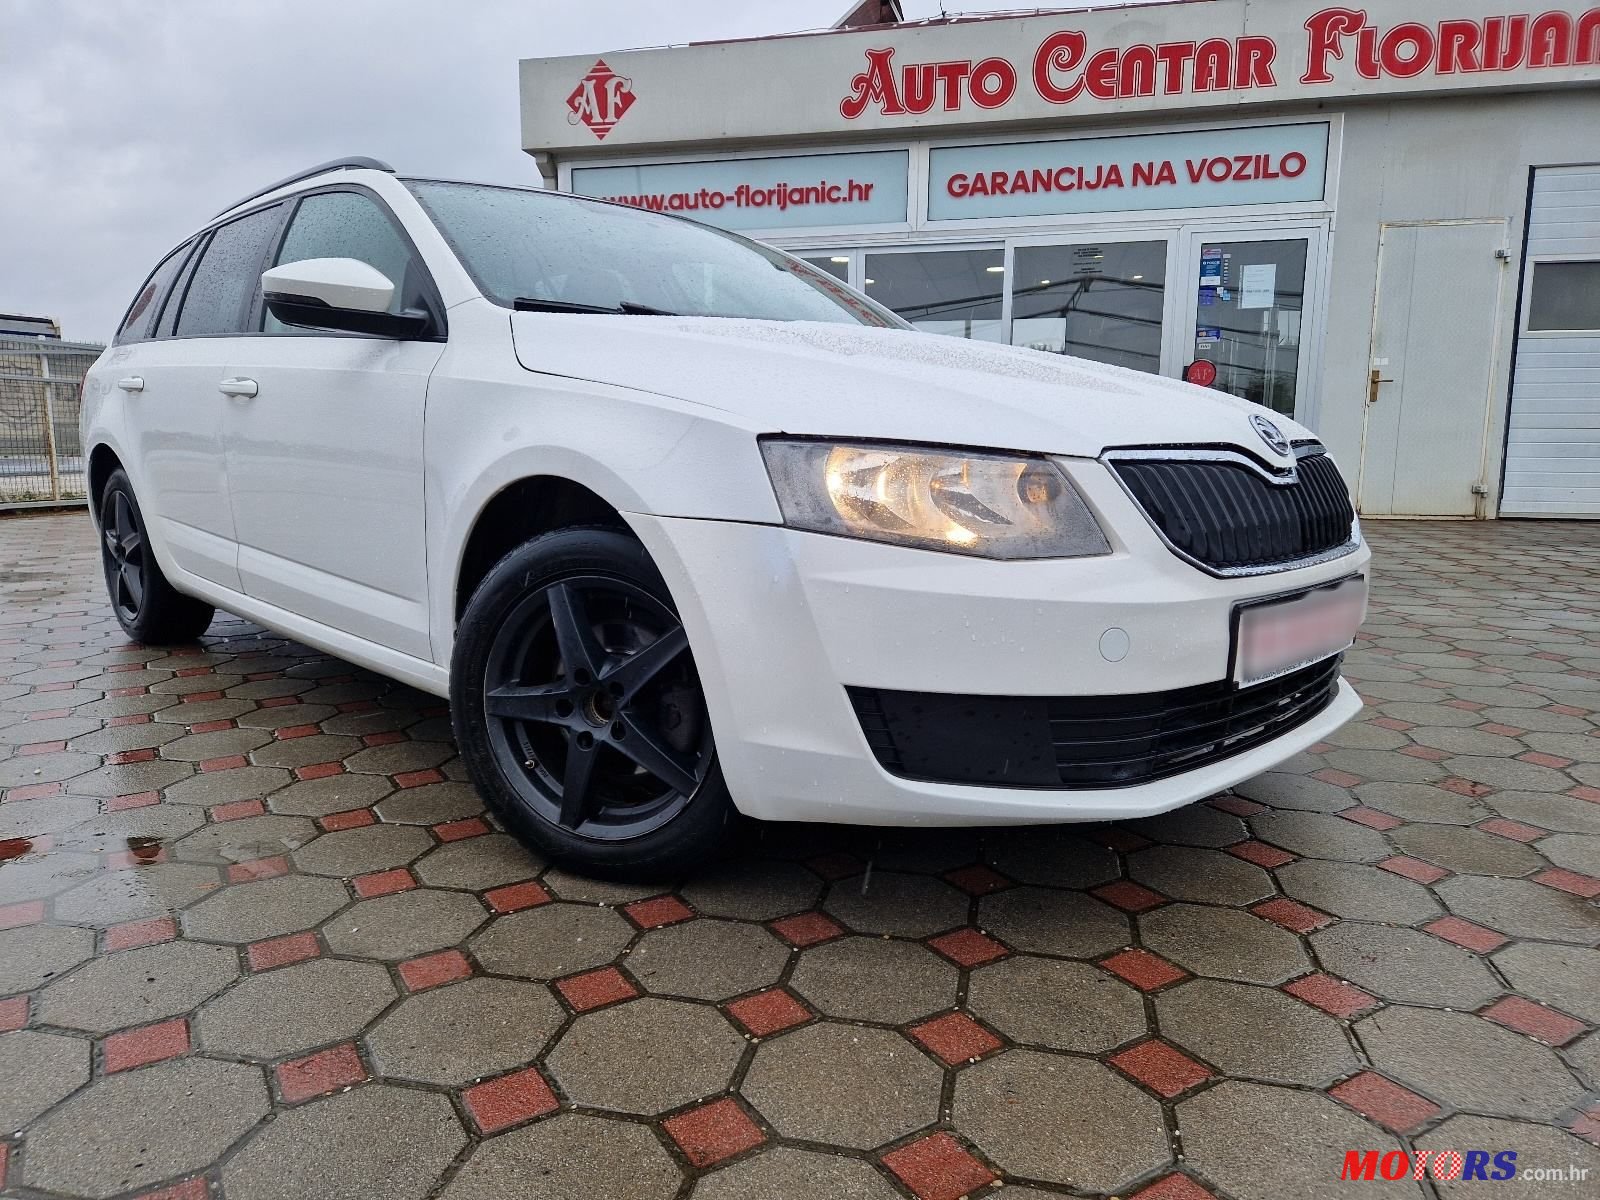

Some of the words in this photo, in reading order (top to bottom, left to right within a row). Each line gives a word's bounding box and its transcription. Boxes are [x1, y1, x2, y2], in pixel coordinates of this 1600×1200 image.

[946, 163, 1125, 198] GARANCIJA
[1131, 160, 1176, 187] NA
[1184, 151, 1308, 184] VOZILO
